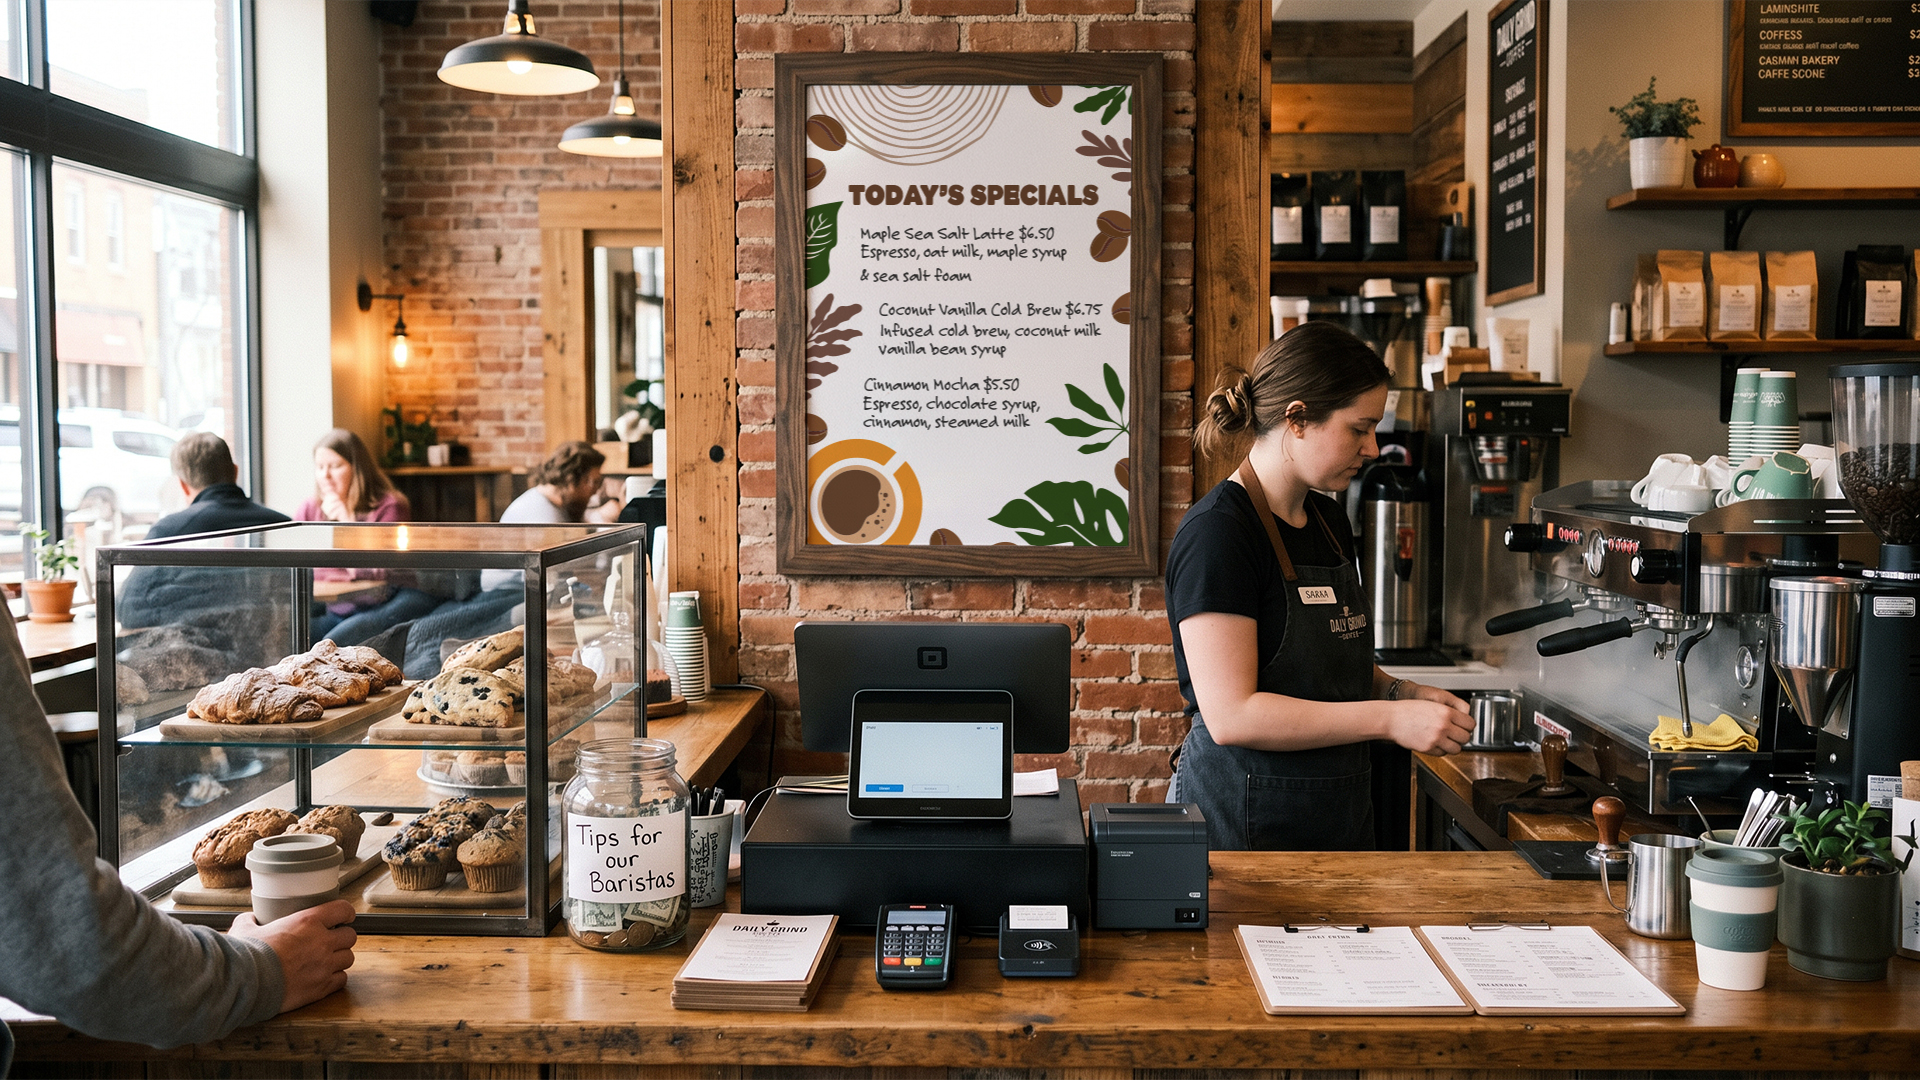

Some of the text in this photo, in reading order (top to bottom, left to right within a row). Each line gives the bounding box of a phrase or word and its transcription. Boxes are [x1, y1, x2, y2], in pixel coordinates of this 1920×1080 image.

[1759, 29, 1803, 40] COFFESS
[1801, 55, 1840, 65] BAKERY
[1758, 68, 1826, 79] CAFFE SCONE
[848, 184, 1099, 206] TODAY'S SPECIALS
[860, 225, 1055, 243] Maple Sea Salt Latte $6.50
[860, 244, 1068, 261] Espresso, oat milk, maple syrup
[859, 268, 972, 282] & sea salt foam
[878, 301, 1103, 318] Coconut Vanilla Cold Brew $6.75
[880, 322, 1102, 339] Infused cold brew, coconut milk
[929, 342, 967, 356] bean
[971, 344, 1007, 358] syrup
[863, 376, 1020, 392] Cinnamon Mocha $5.50
[862, 396, 1040, 414] Espresso, chocolate syrup,
[862, 414, 1029, 430] cinnamon, steamed milk
[576, 823, 663, 853] Tips for
[605, 854, 640, 869] our
[589, 870, 676, 893] Baristas
